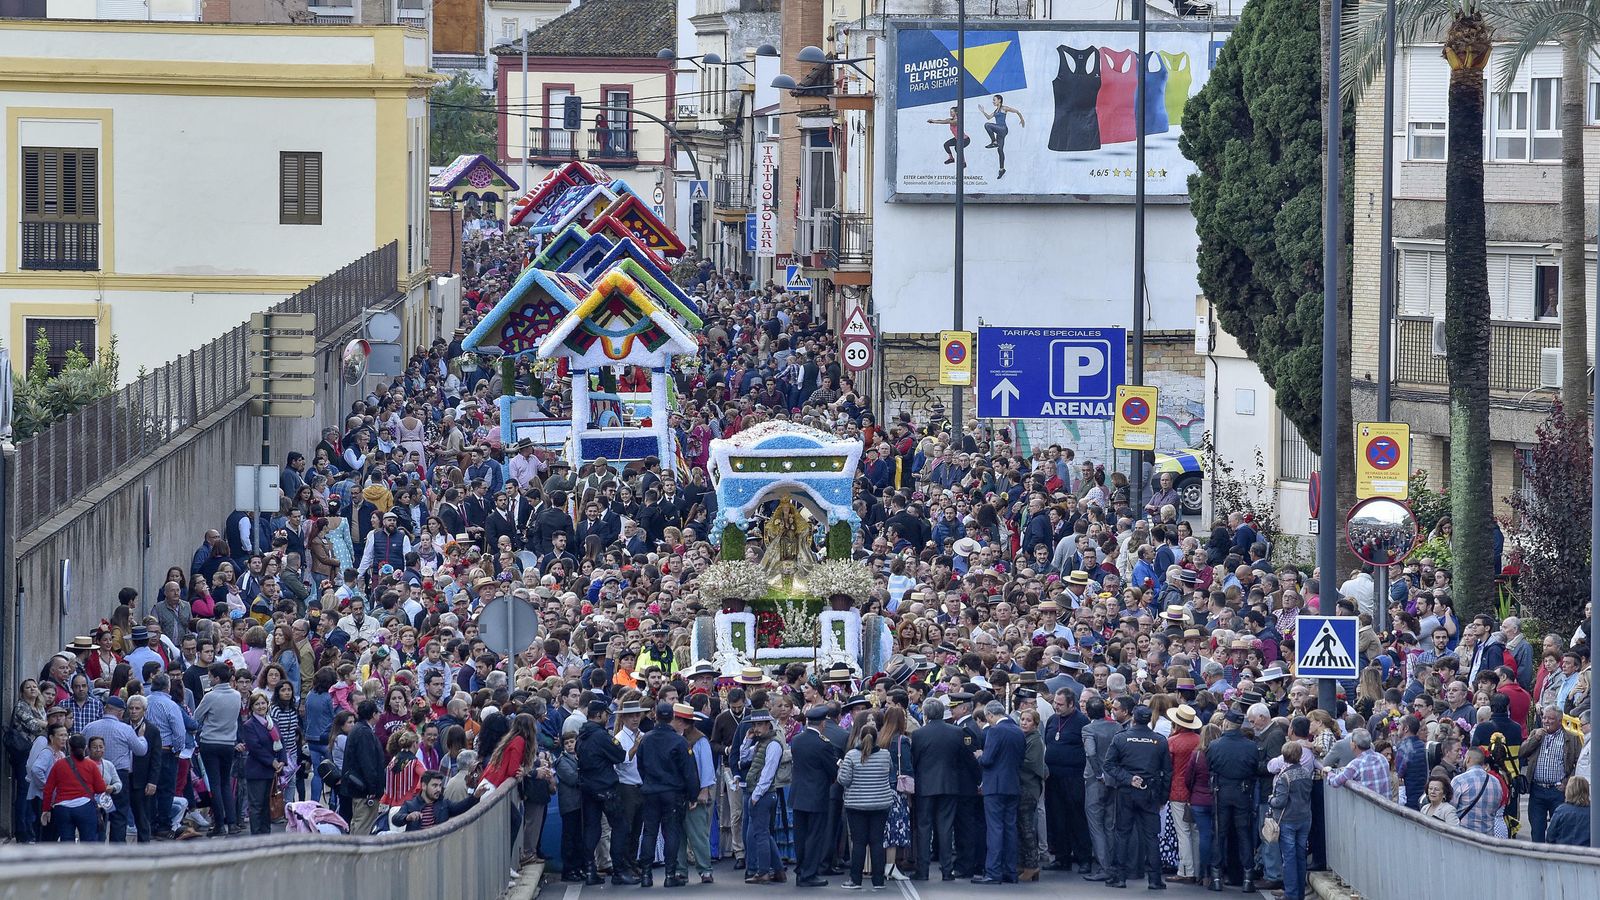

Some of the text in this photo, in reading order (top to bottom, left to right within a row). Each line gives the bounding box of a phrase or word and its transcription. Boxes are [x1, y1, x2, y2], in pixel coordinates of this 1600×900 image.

[904, 57, 949, 74] BAJAMOS
[910, 66, 959, 83] EL PRECIO
[909, 76, 959, 93] PARA SIEMPR
[762, 146, 773, 200] TATTOO
[1089, 168, 1109, 177] 4,6/5
[1002, 329, 1041, 337] TARIFAS
[847, 349, 867, 360] 30
[1063, 346, 1105, 394] P
[1040, 401, 1115, 416] ARENAL
